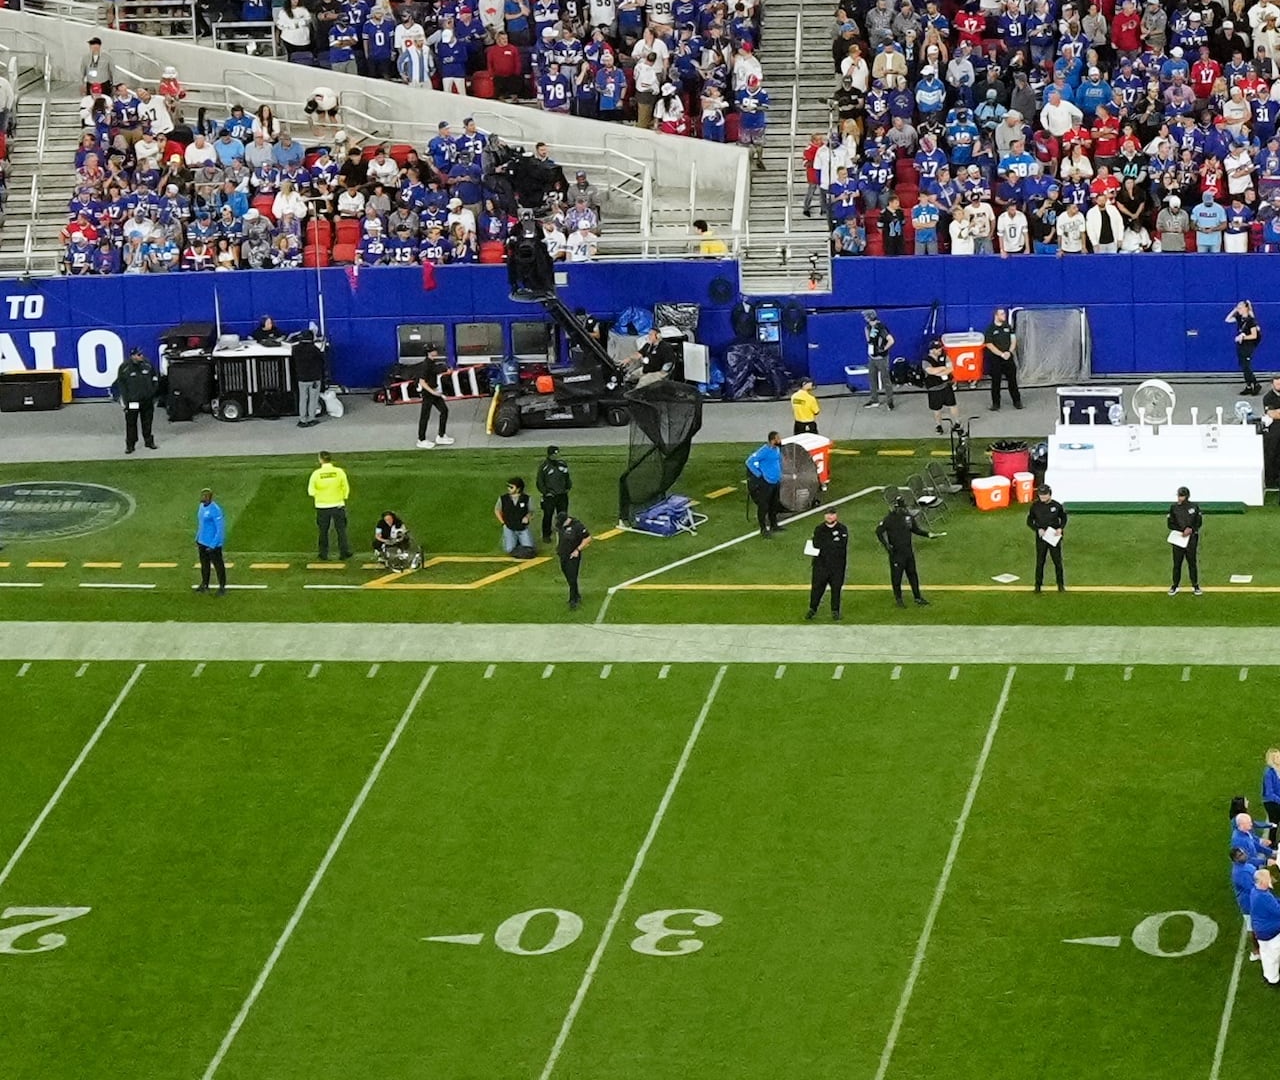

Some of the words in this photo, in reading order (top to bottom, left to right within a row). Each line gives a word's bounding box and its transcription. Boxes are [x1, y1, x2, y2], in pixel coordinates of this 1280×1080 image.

[567, 1, 577, 15] 9
[655, 2, 670, 15] 99
[962, 18, 977, 31] 17
[1009, 21, 1022, 35] 91
[547, 84, 565, 100] 78
[1256, 106, 1269, 121] 31
[73, 251, 87, 266] 12
[6, 295, 44, 320] TO
[1132, 910, 1219, 957] 0
